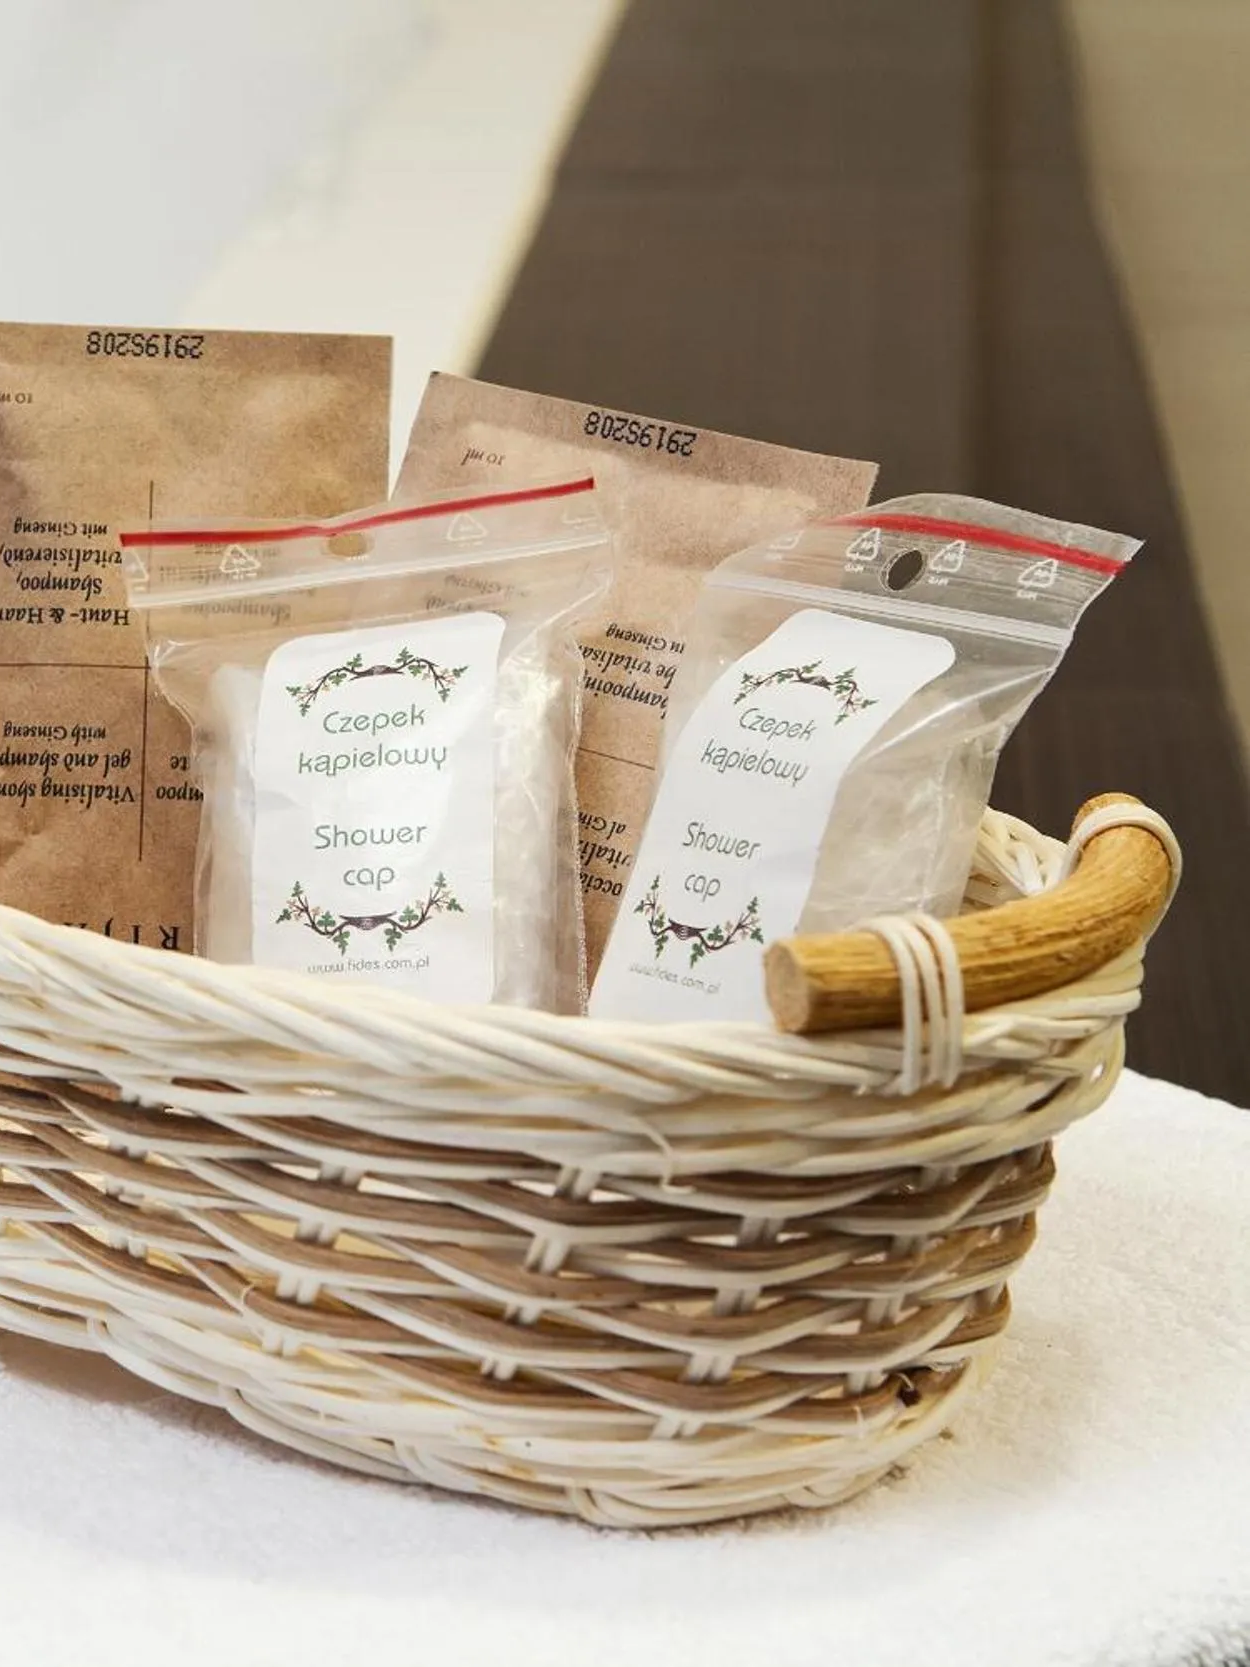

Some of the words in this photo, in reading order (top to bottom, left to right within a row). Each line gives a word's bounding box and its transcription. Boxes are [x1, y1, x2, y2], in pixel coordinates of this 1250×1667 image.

[85, 331, 204, 359] 2919S208
[583, 410, 697, 457] 2919S208
[13, 517, 76, 536] Ginseng
[79, 521, 108, 536] mit
[49, 607, 65, 624] &
[70, 607, 130, 626] Haut-
[605, 623, 667, 651] Ginseng
[578, 645, 651, 675] vitalisa
[3, 721, 67, 740] Ginseng
[322, 703, 426, 737] Czepek
[738, 706, 818, 742] Czepek
[68, 725, 106, 746] with
[64, 752, 98, 767] and
[99, 749, 131, 778] gel
[297, 743, 448, 777] kąpielowy
[700, 738, 810, 786] kąpielowy
[41, 778, 135, 808] Vitalising
[313, 823, 428, 850] Shower
[681, 821, 762, 861] Shower
[342, 864, 396, 891] cap
[683, 874, 722, 903] cap
